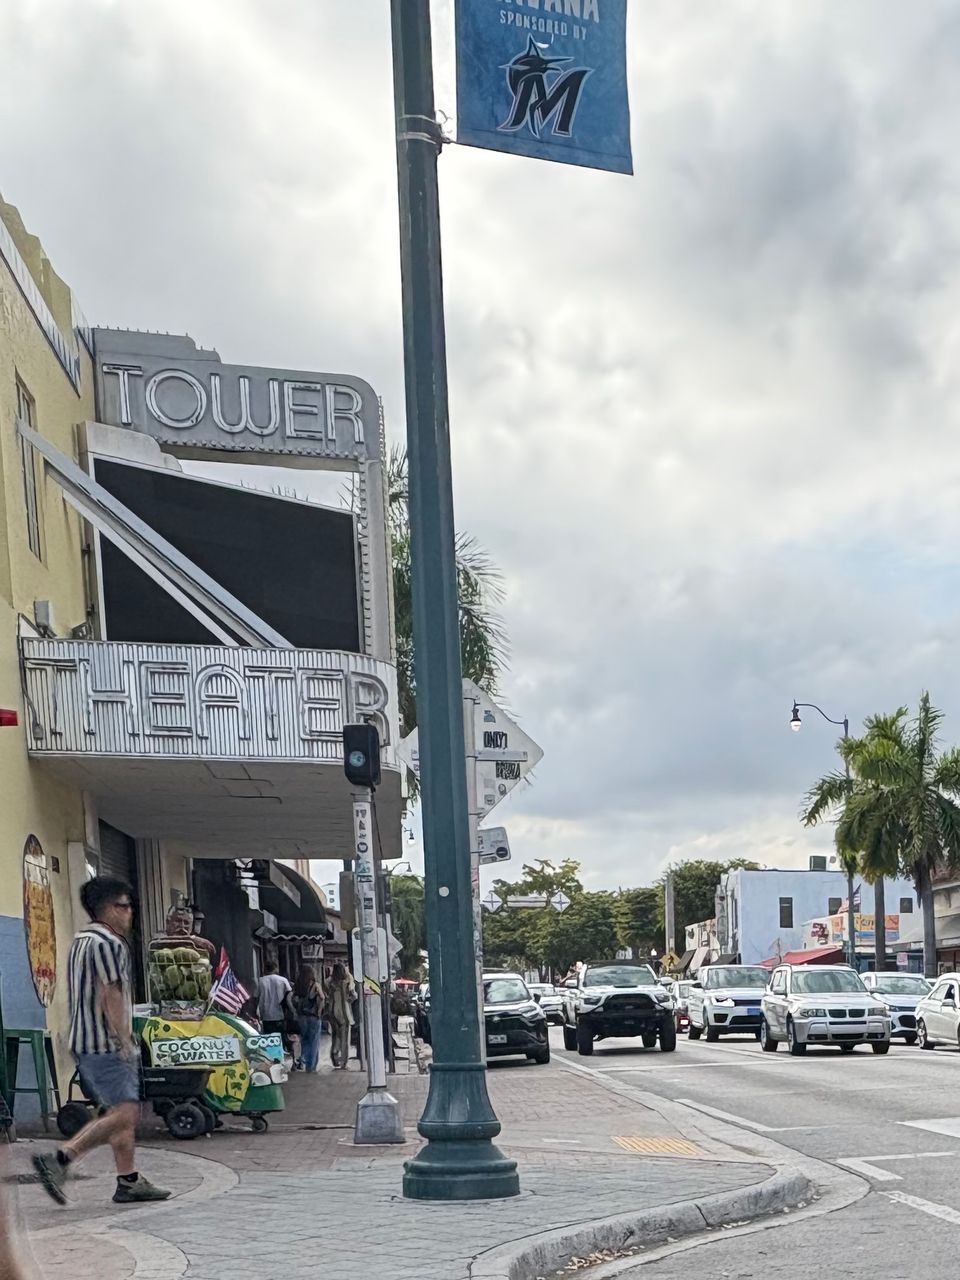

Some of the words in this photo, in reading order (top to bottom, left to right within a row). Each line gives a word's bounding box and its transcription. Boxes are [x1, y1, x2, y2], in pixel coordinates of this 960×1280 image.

[500, 10, 568, 36] SPONSORED
[573, 24, 587, 40] BY
[102, 363, 365, 444] TOWER
[25, 658, 391, 748] THEATER
[180, 1050, 234, 1061] WATER
